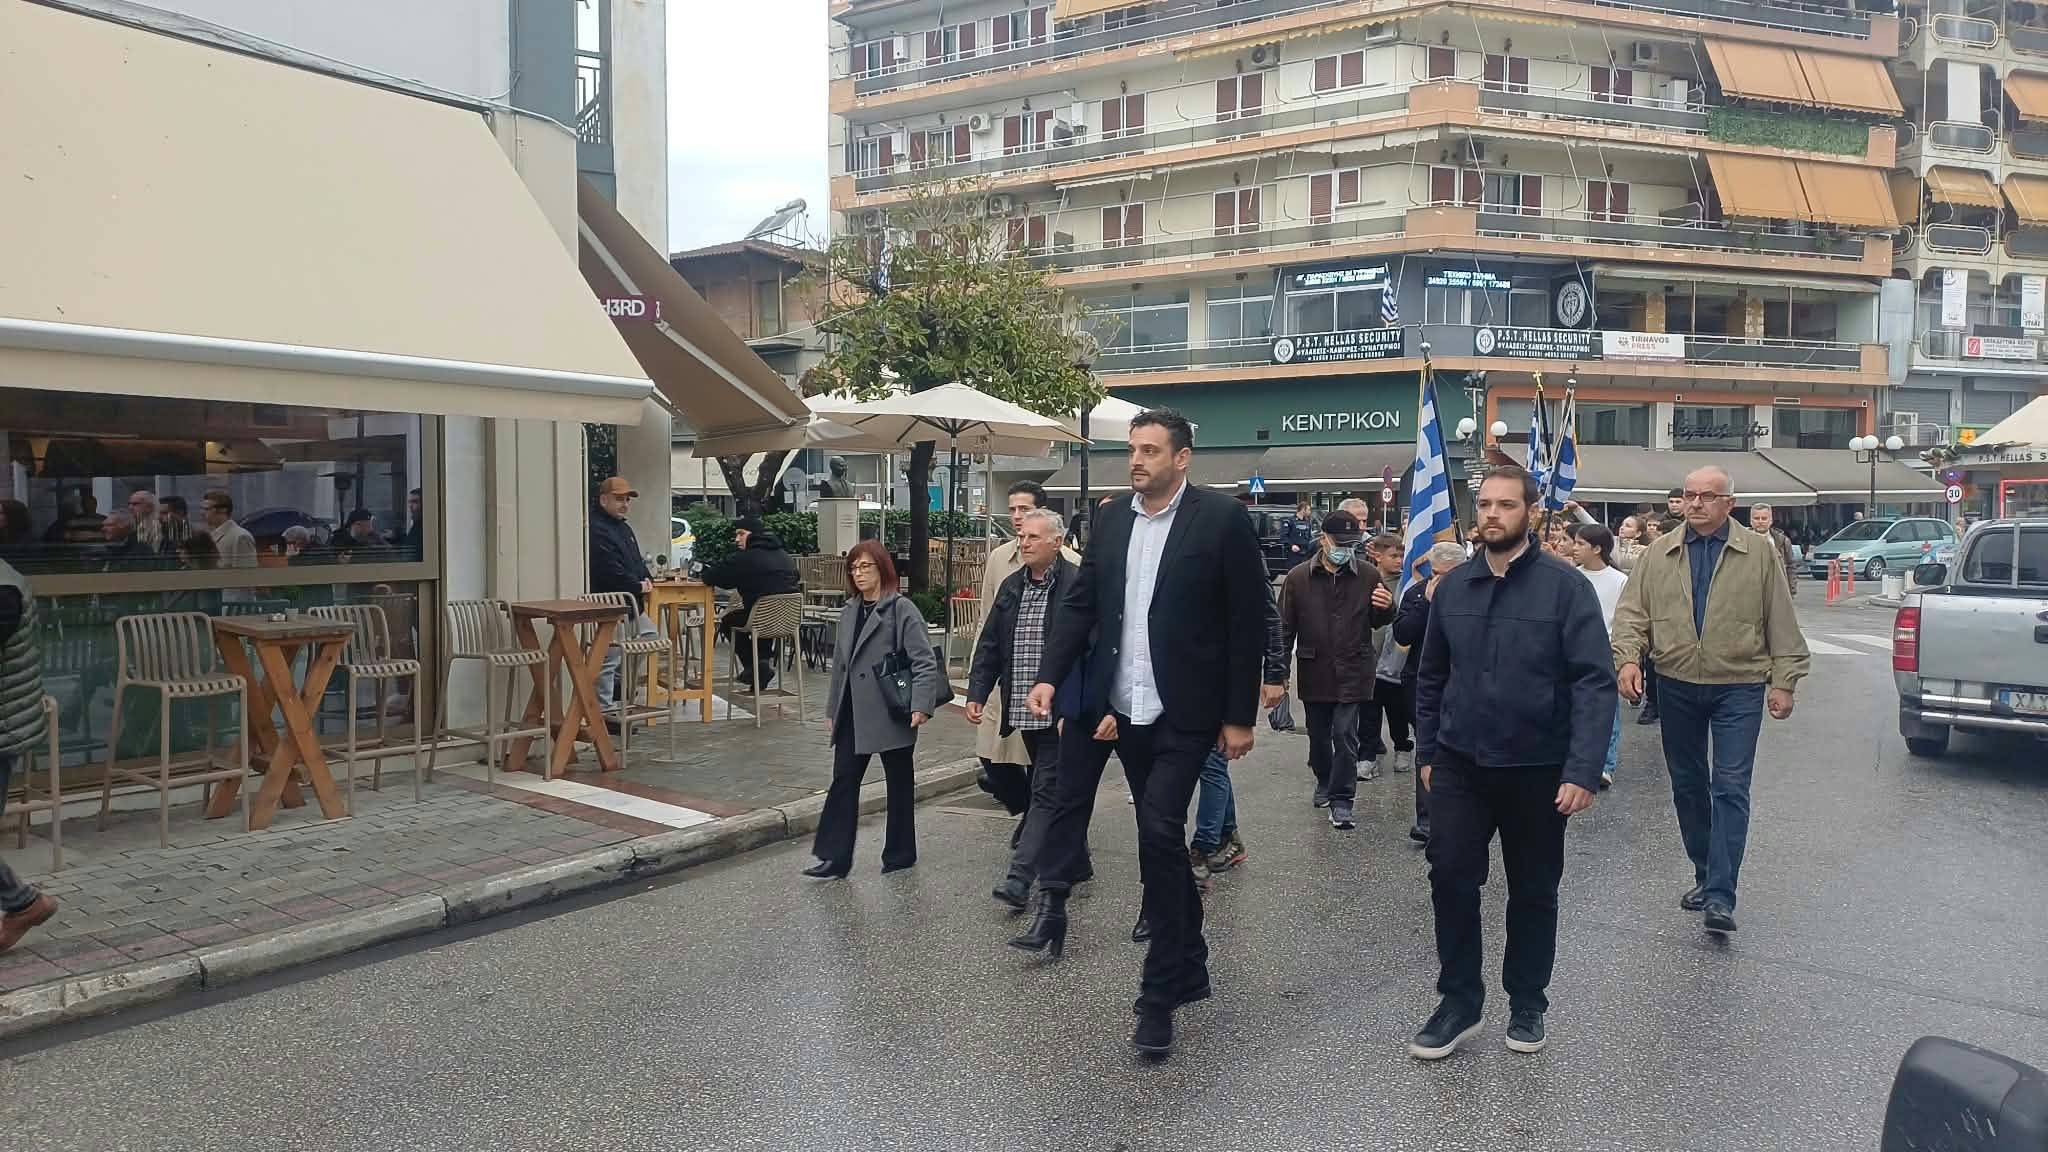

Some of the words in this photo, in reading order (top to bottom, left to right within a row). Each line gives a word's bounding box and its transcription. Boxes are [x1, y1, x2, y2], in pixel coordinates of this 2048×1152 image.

[1324, 333, 1356, 346] HELLAS
[1358, 330, 1401, 344] SECURITY
[1523, 330, 1552, 343] HELLAS
[1553, 332, 1591, 345] SECURITY
[1631, 335, 1670, 344] TIRNAVOS
[1282, 410, 1400, 432] ΚΕΝΤΡΙΚΟΝ
[2000, 452, 2033, 462] HELLAS
[1383, 491, 1392, 500] 30
[1948, 489, 1960, 498] 30
